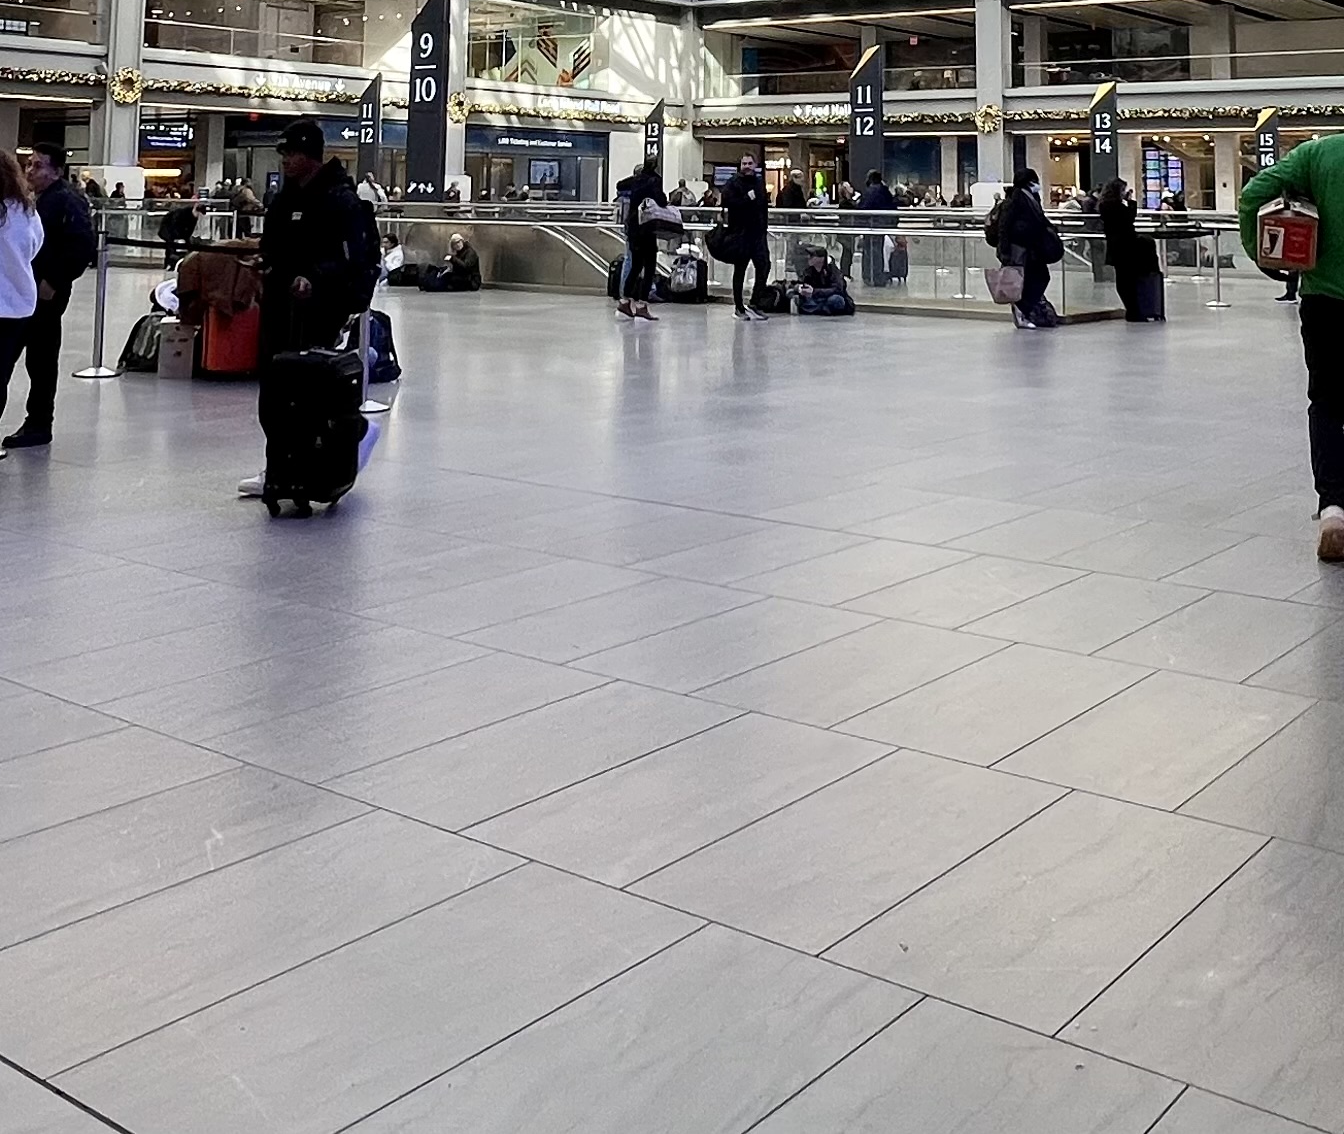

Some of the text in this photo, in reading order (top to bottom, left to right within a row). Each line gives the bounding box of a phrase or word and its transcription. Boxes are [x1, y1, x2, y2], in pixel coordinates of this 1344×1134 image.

[419, 32, 434, 58] 9
[414, 76, 437, 102] 10
[856, 84, 872, 104] 11
[362, 103, 373, 119] 11
[805, 104, 829, 117] Food
[856, 116, 874, 136] 12
[1094, 112, 1111, 129] 13
[360, 127, 374, 143] 12
[647, 122, 659, 137] 13
[1094, 137, 1112, 154] 14
[1259, 133, 1273, 147] 15
[646, 143, 659, 156] 14
[1260, 153, 1275, 166] 16
